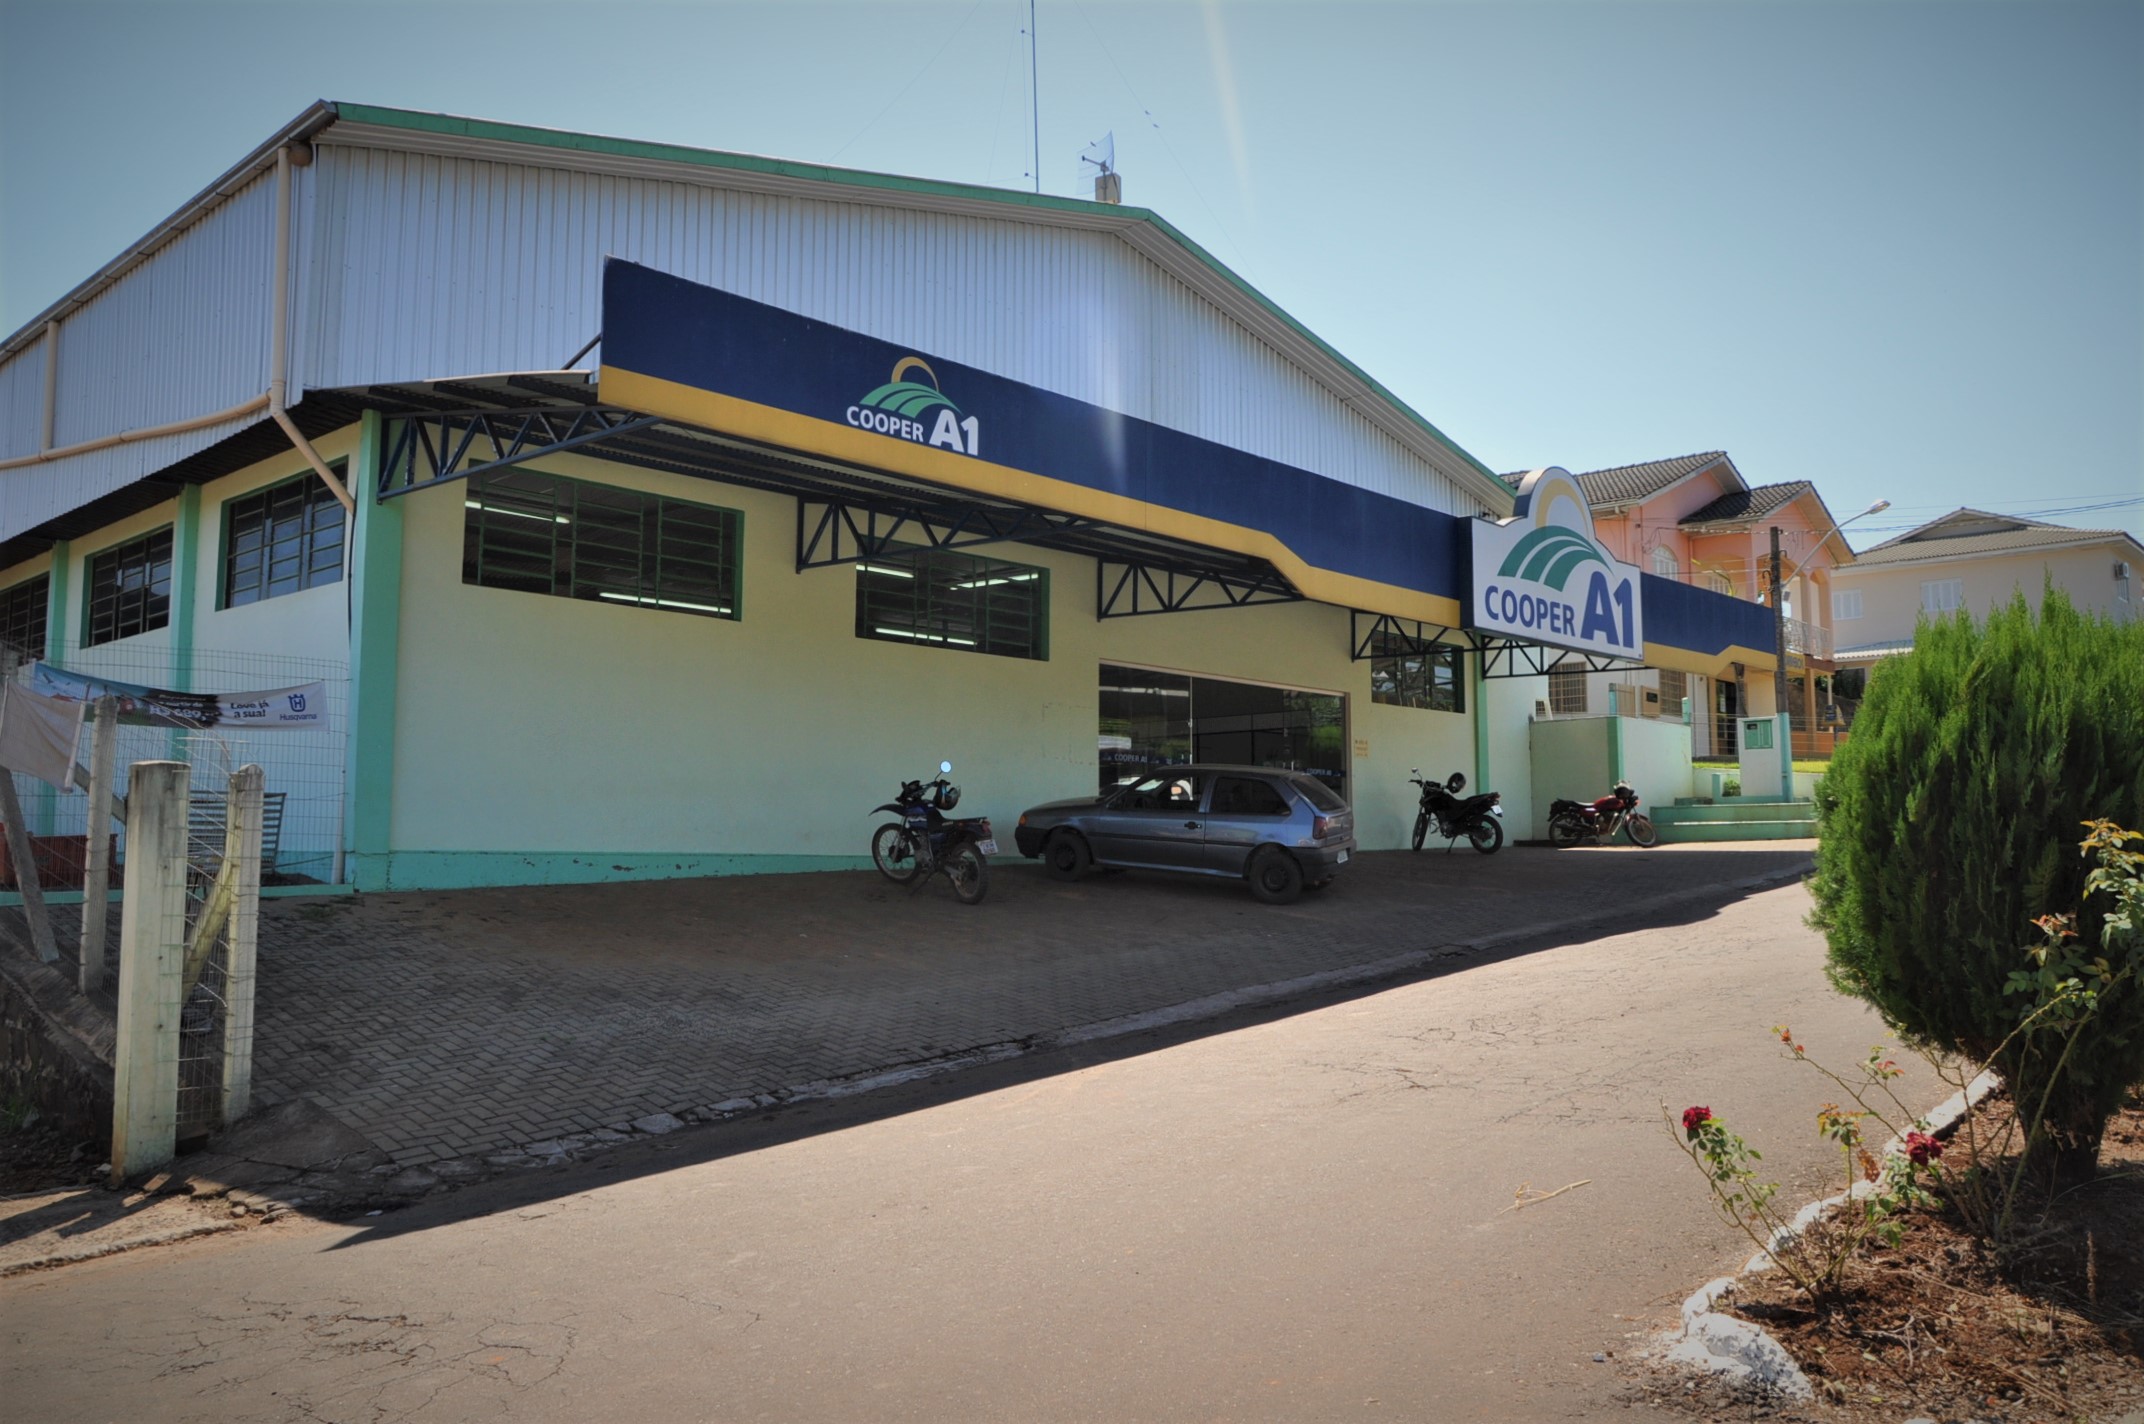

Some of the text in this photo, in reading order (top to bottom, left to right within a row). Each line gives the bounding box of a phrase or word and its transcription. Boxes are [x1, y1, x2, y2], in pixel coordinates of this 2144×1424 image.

[846, 405, 979, 456] COOPER A1
[1484, 570, 1634, 649] COOPER A1
[243, 709, 266, 718] sua!
[280, 713, 317, 722] Husqvarna
[1114, 753, 1139, 763] COOPER
